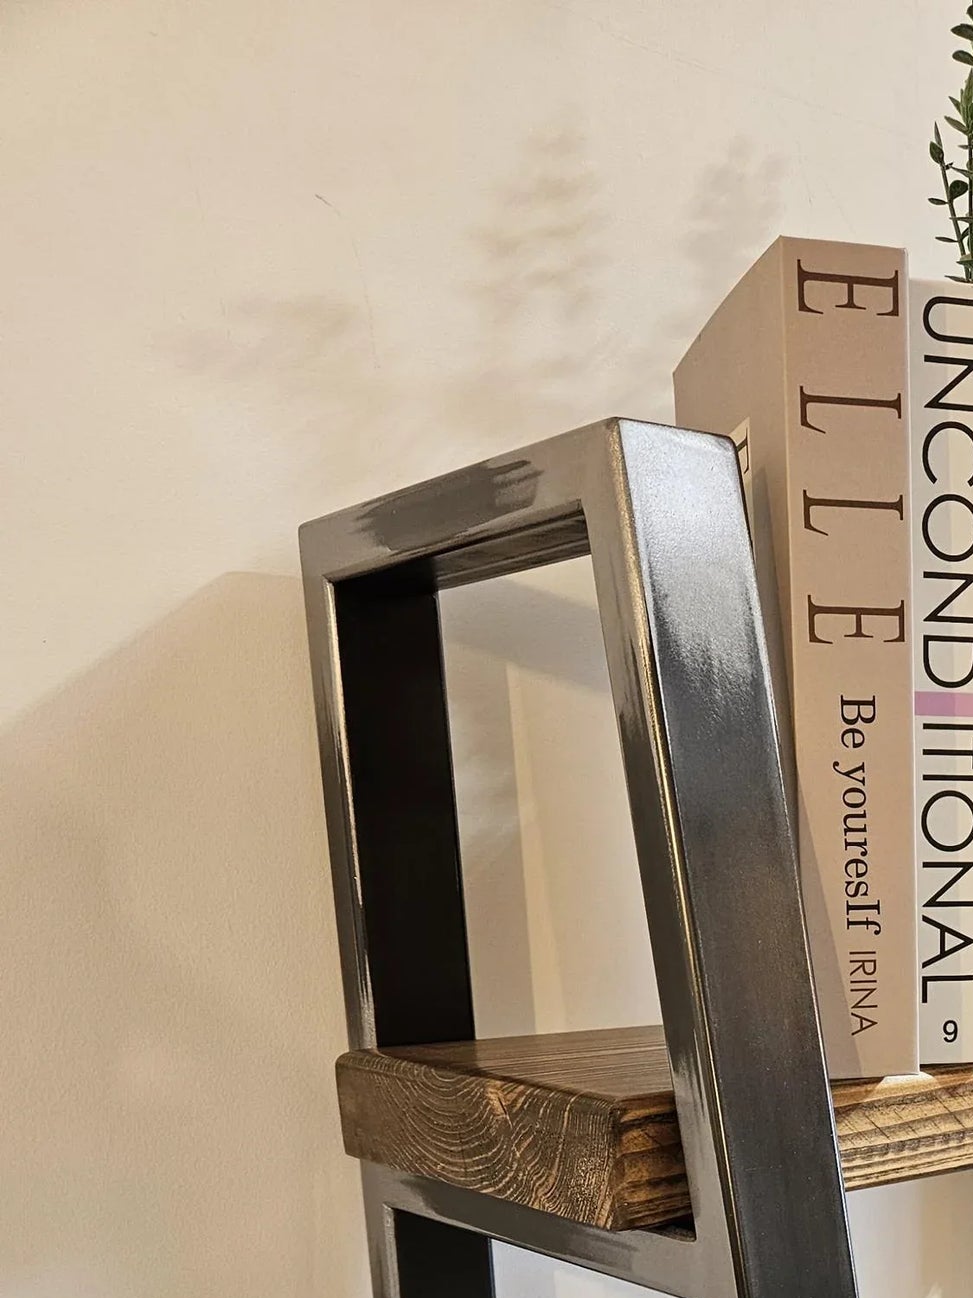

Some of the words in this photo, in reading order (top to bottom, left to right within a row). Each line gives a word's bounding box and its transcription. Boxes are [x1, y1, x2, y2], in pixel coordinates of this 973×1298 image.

[797, 259, 906, 645] ELLE
[839, 695, 877, 749] Be
[848, 950, 878, 1037] IRINA
[942, 1019, 959, 1043] 9
